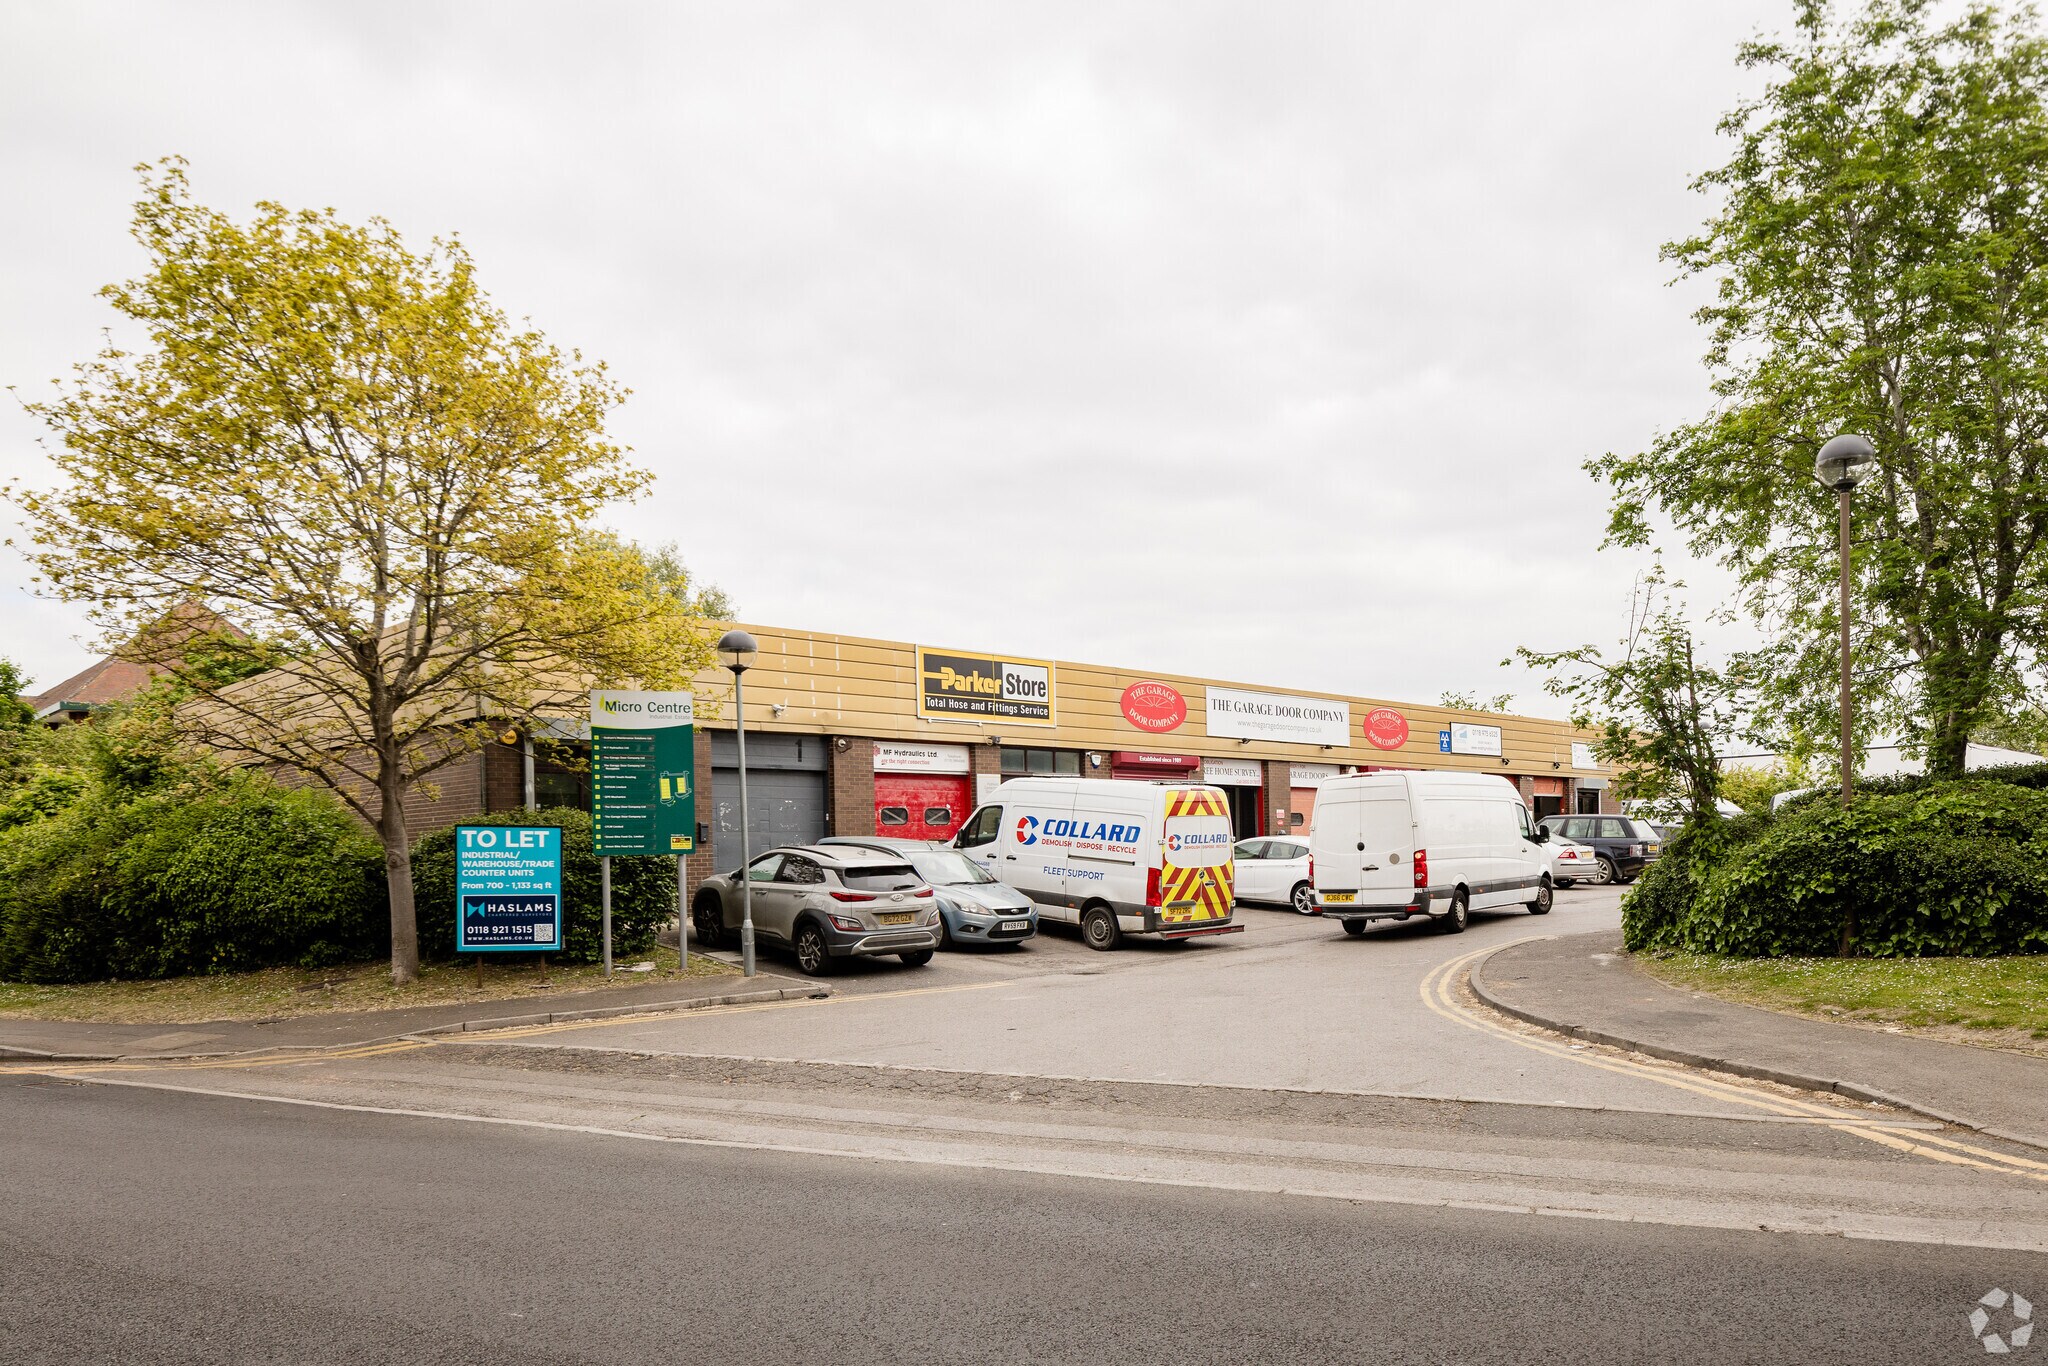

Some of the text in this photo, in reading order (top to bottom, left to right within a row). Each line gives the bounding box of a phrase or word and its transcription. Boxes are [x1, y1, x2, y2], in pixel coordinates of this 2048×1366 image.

[940, 666, 1046, 698] Parker Store
[1130, 686, 1176, 704] THE GARAGE
[605, 701, 691, 713] Micro Centre
[926, 697, 1048, 716] Total Hose and Fittings Service
[1211, 698, 1345, 722] THE GARAGE DOOR COMPANY
[1129, 708, 1178, 728] DOOR COMPANY
[1380, 711, 1401, 726] GARAGE
[894, 750, 925, 758] Hydraulics
[1215, 768, 1233, 776] HOME
[1043, 819, 1141, 843] COLLARD
[461, 830, 549, 848] TO LET
[1042, 838, 1136, 854] DEMOLISH DISPOSE RECYCLE
[1184, 834, 1228, 844] COLLARD
[1043, 866, 1104, 880] FLEET SUPPORT
[488, 904, 552, 912] HASLAMS
[467, 926, 489, 934] 0118
